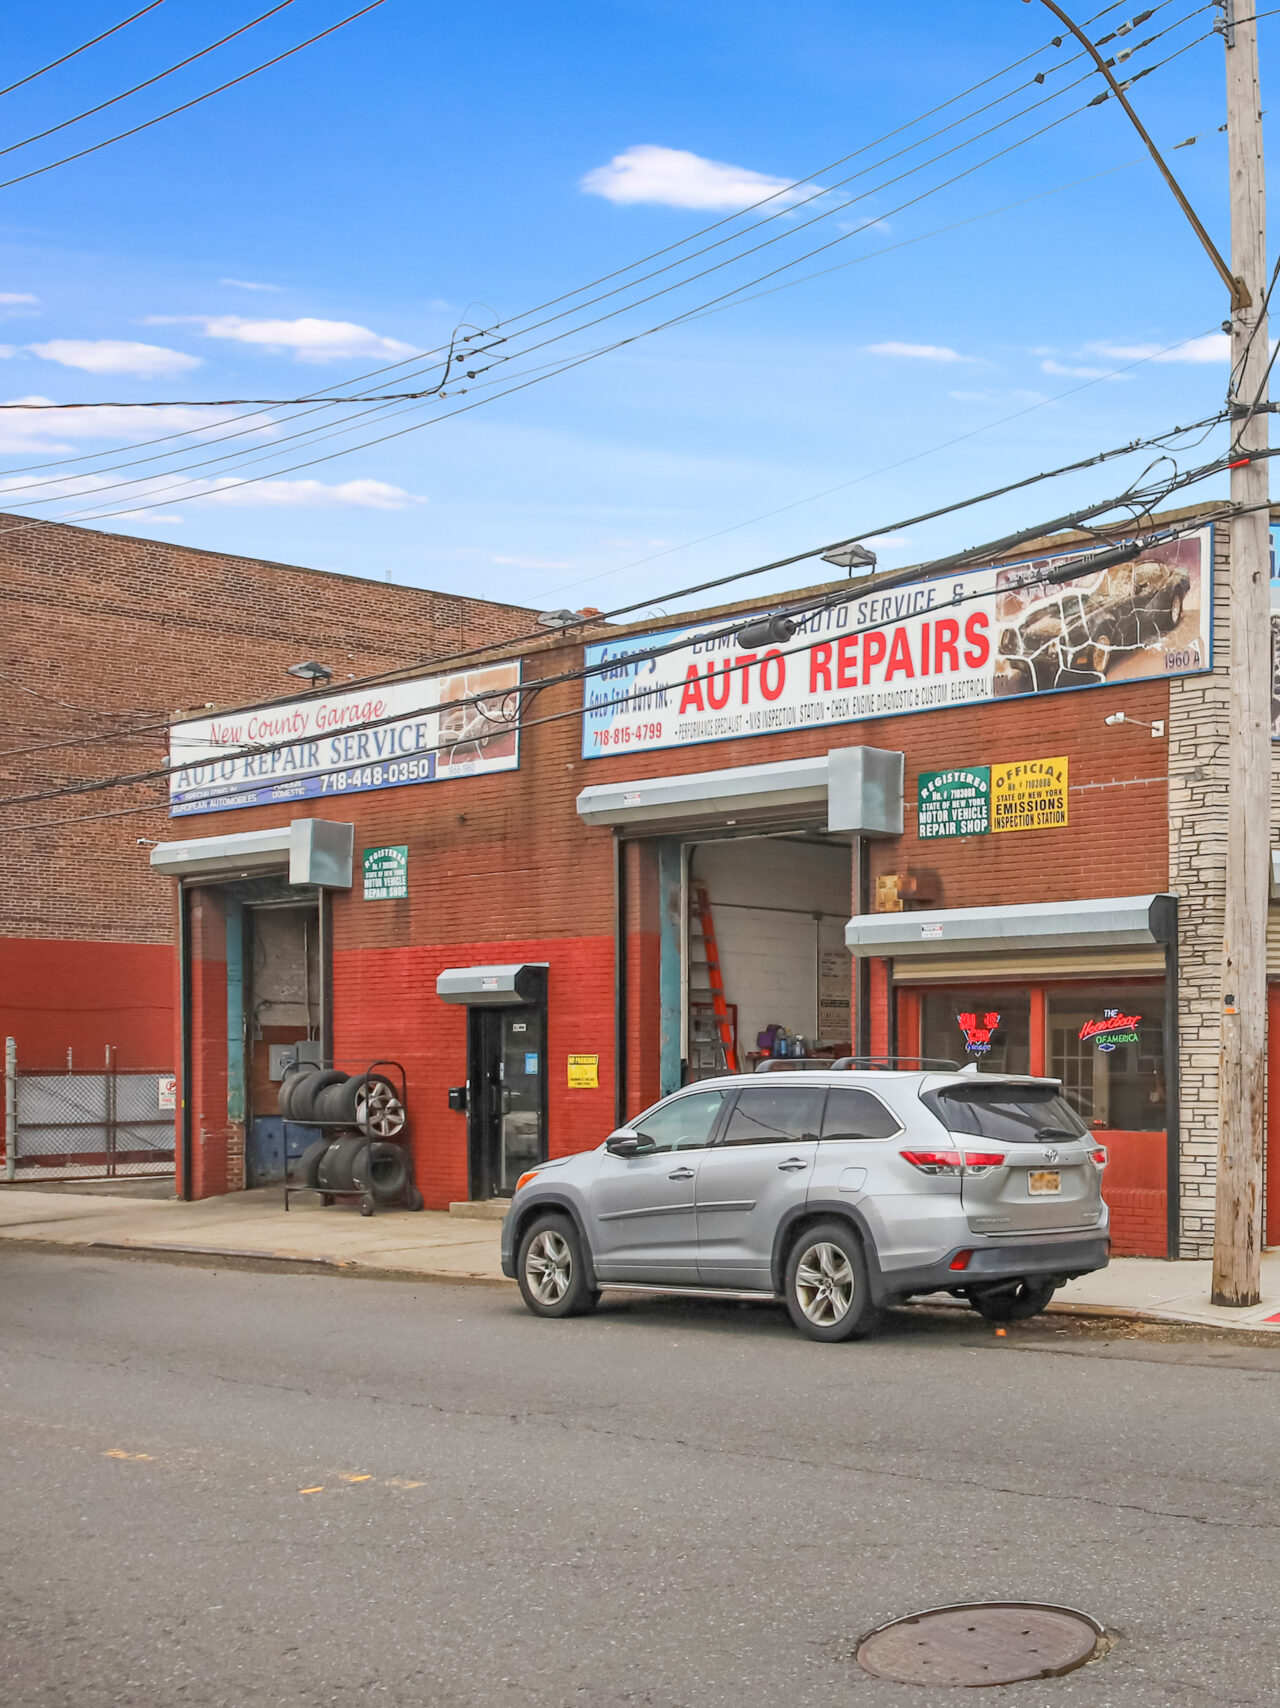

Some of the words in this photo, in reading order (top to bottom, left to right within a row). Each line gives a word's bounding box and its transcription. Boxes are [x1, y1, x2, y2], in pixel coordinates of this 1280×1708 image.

[797, 605, 849, 636] AUTO
[857, 588, 936, 625] SERVICE
[952, 584, 964, 607] &
[677, 648, 787, 715] AUTO
[809, 611, 990, 694] REPAIRS
[1165, 650, 1190, 669] 1960
[589, 689, 609, 719] GOLD
[611, 687, 630, 716] STAR
[632, 682, 652, 713] AUTO
[762, 706, 797, 728] INSPECTION
[799, 702, 825, 723] STATION
[831, 697, 850, 719] CHECK
[853, 694, 875, 715] ENGINE
[877, 689, 913, 712] DIAGNOSTIC
[921, 683, 948, 705] CUSTOM
[951, 677, 988, 701] ELECTRICAL
[210, 723, 243, 747] New
[248, 708, 309, 739] County
[315, 699, 388, 731] Garage
[593, 722, 663, 747] 718-815-4799
[177, 758, 236, 788] AUTO
[244, 742, 320, 777] REPAIR
[330, 723, 428, 765] SERVICE
[320, 759, 429, 793] 718-448-0350
[920, 771, 987, 800] REGISTERED
[996, 764, 1063, 788] OFFICIAL
[922, 801, 941, 812] STATE
[942, 800, 951, 810] OF
[952, 799, 967, 809] NEW
[968, 797, 986, 807] YORK
[996, 793, 1015, 803] STATE
[1018, 792, 1026, 801] OF
[1028, 791, 1042, 800] NEW
[1045, 788, 1063, 798] YORK
[996, 797, 1064, 816] EMISSIONS
[920, 809, 949, 824] MOTOR
[951, 805, 988, 821] VEHICLE
[994, 813, 1035, 830] INSPECTION
[1037, 810, 1065, 825] STATION
[920, 821, 957, 838] REPAIR
[960, 818, 988, 834] SHOP
[1103, 1009, 1119, 1018] THE
[1095, 1035, 1107, 1044] OF
[1106, 1033, 1139, 1043] AMERICA
